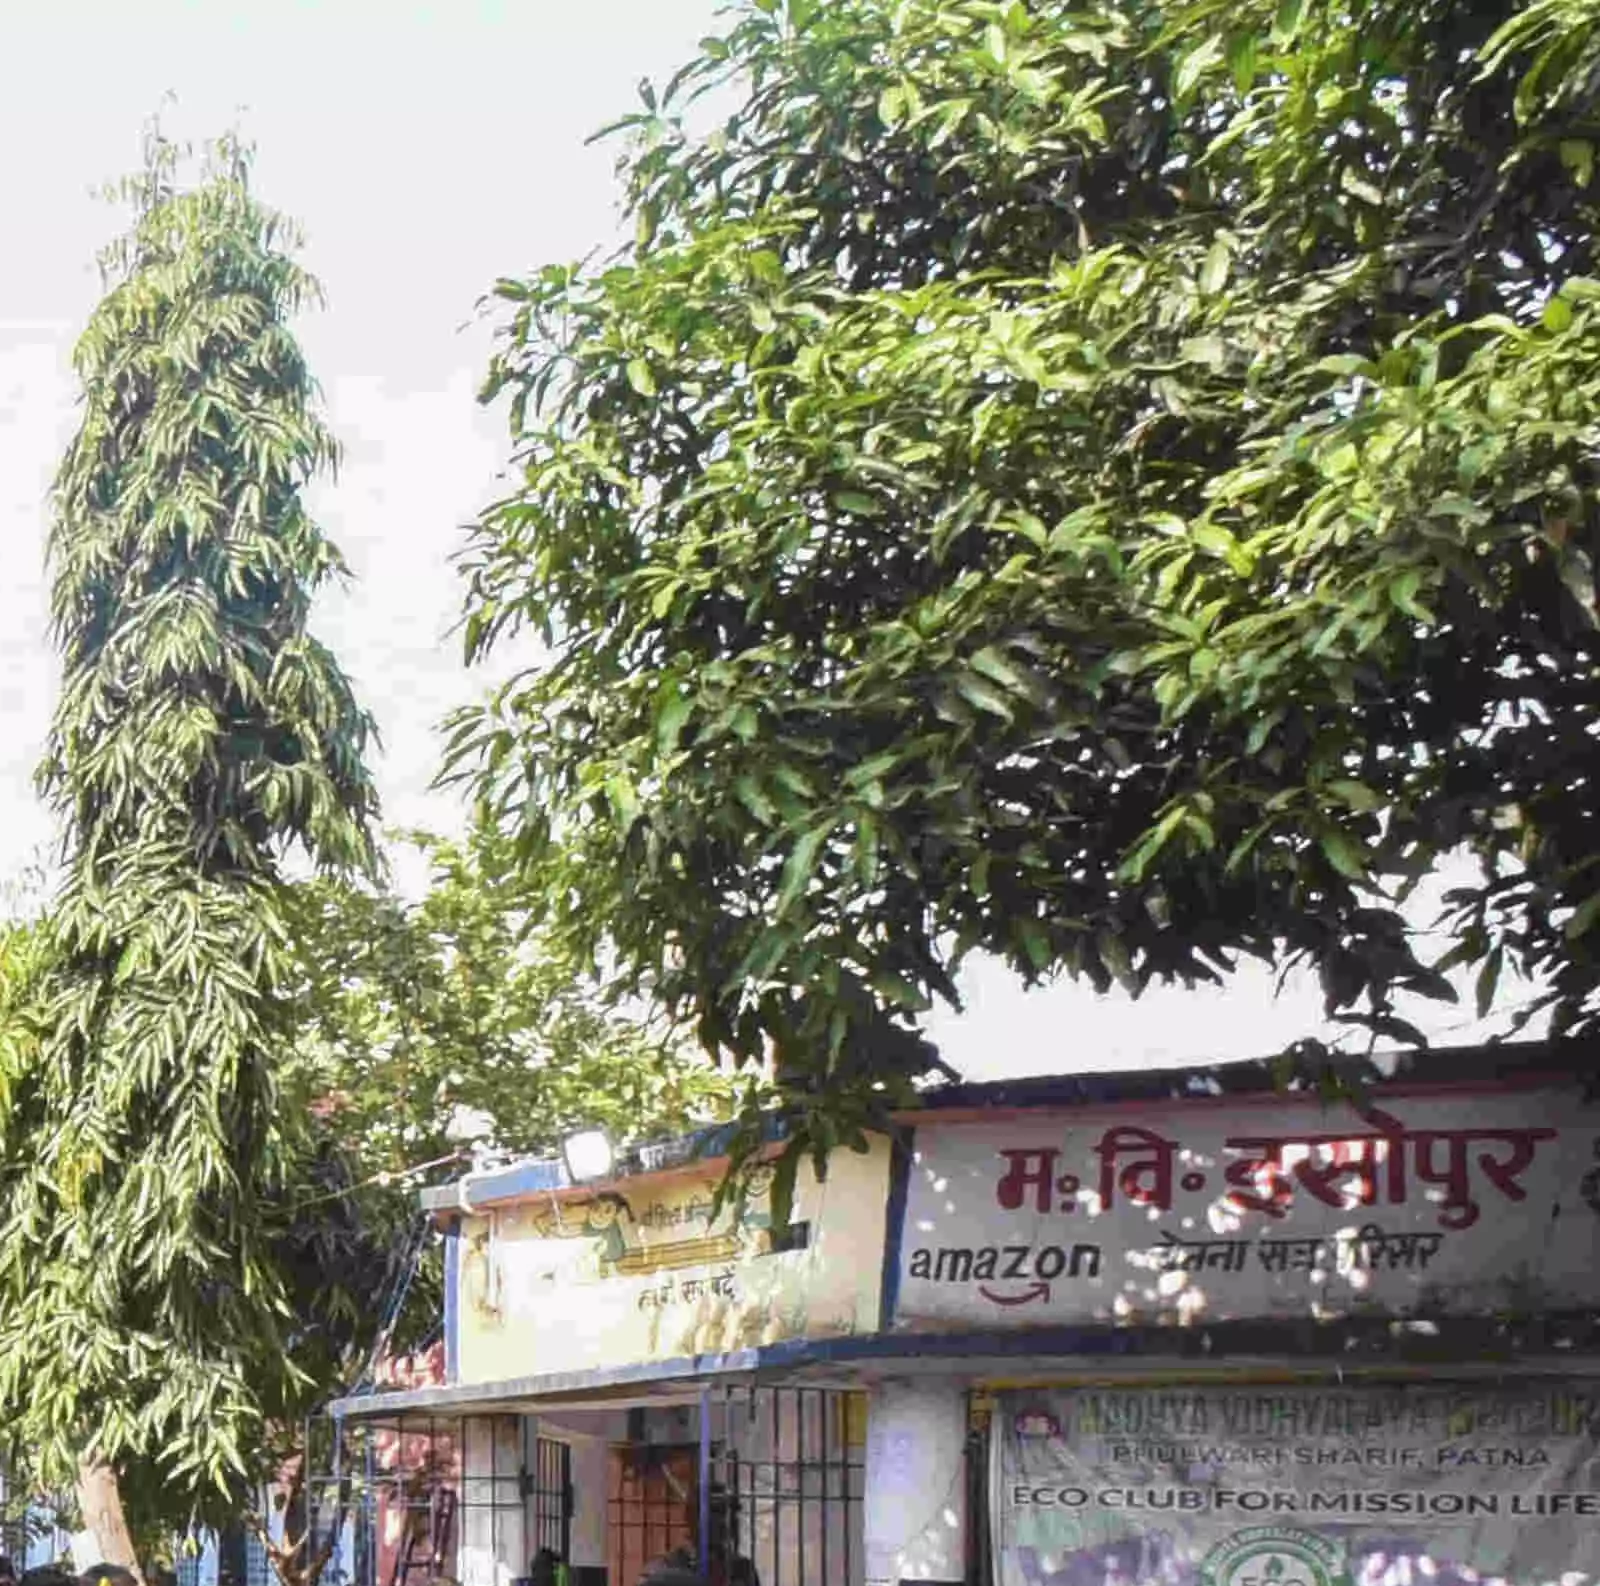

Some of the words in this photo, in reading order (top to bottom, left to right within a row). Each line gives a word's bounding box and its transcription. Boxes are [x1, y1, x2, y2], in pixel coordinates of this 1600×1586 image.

[910, 1245, 1101, 1282] amazon
[1437, 1447, 1550, 1466] PATNA
[1012, 1486, 1089, 1507] ECO
[1097, 1488, 1202, 1510] CLUB
[1214, 1490, 1297, 1511] FOR
[1310, 1493, 1498, 1514] MISSION
[1510, 1494, 1600, 1516] LIFE
